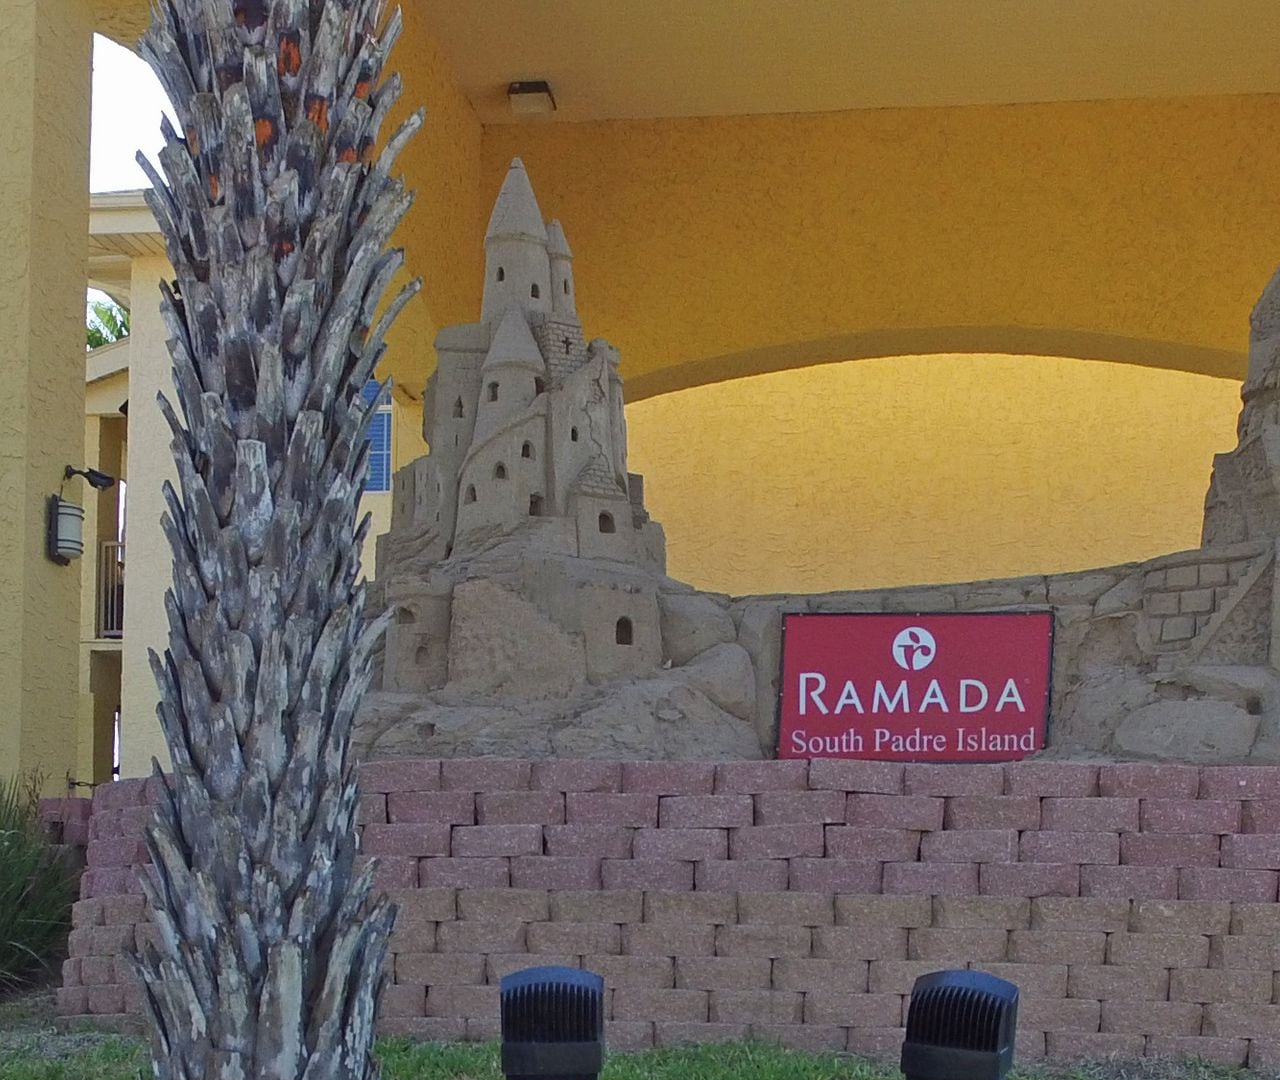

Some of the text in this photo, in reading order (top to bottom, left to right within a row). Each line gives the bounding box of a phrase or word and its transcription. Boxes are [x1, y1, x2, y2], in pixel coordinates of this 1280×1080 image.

[799, 673, 1026, 715] RAMADA
[791, 727, 1035, 753] South Padre Island
